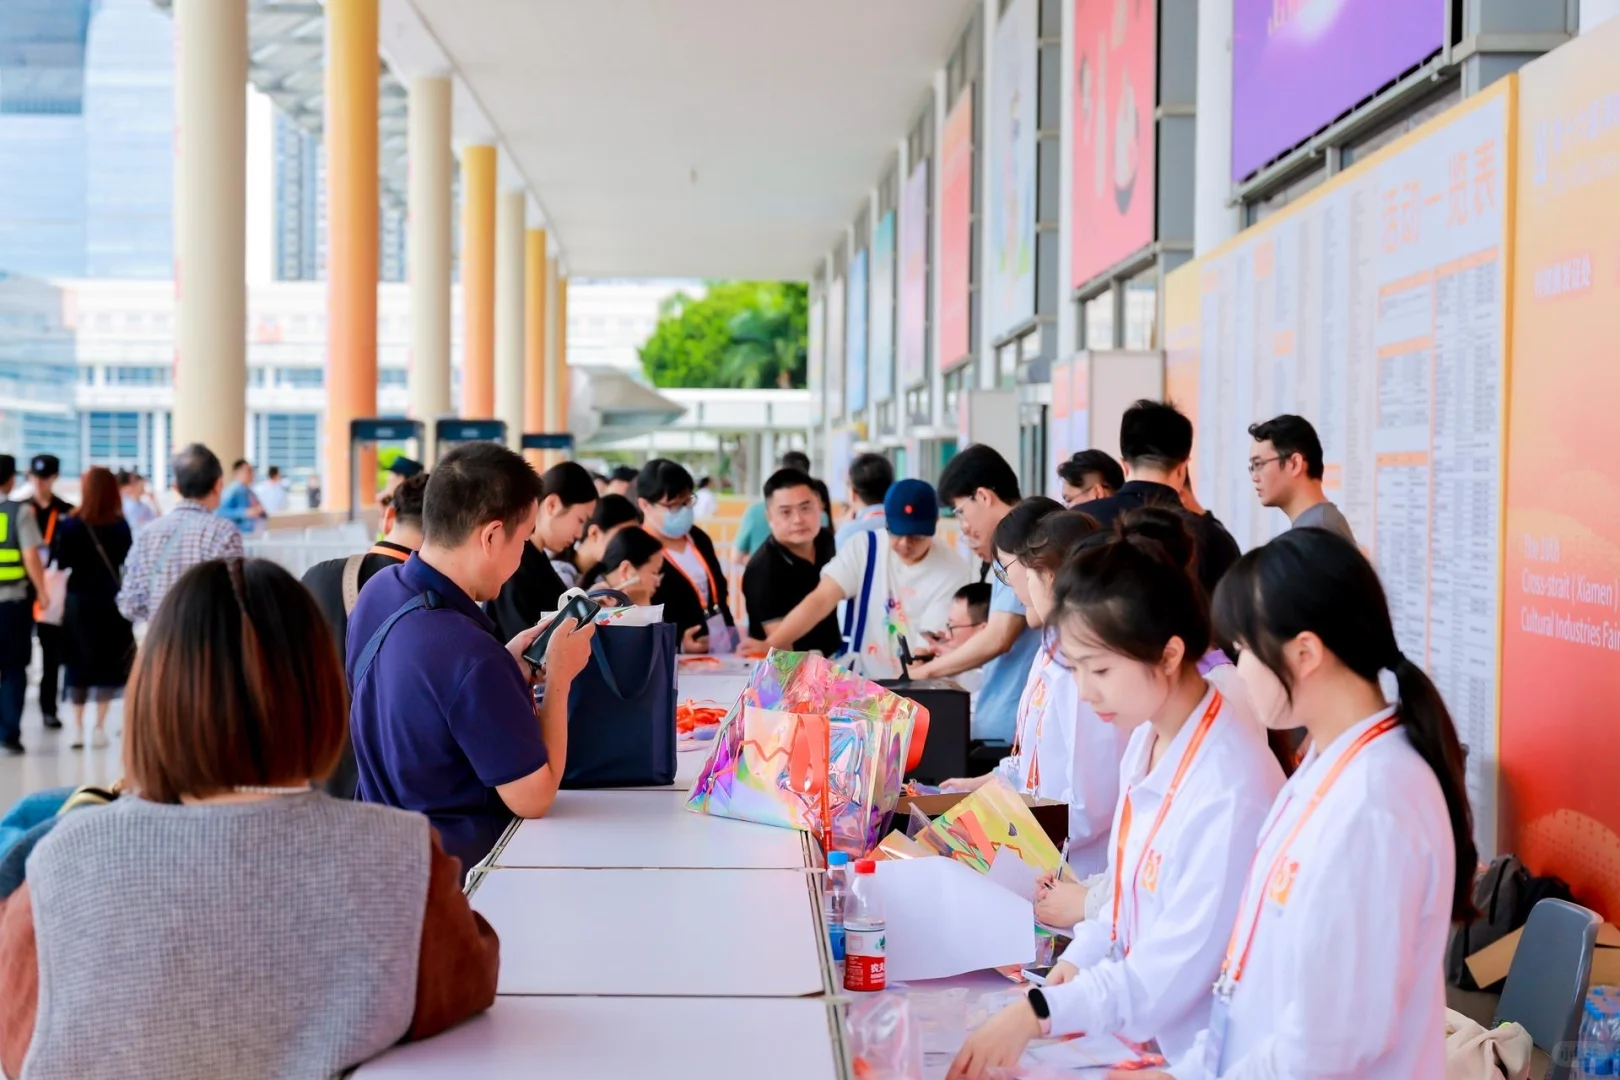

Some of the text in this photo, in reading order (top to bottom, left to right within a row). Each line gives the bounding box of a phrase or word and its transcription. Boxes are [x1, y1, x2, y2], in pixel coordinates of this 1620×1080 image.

[1522, 567, 1570, 600] Cross-strait
[1521, 605, 1554, 637] Cultural
[1556, 610, 1601, 648] Industries
